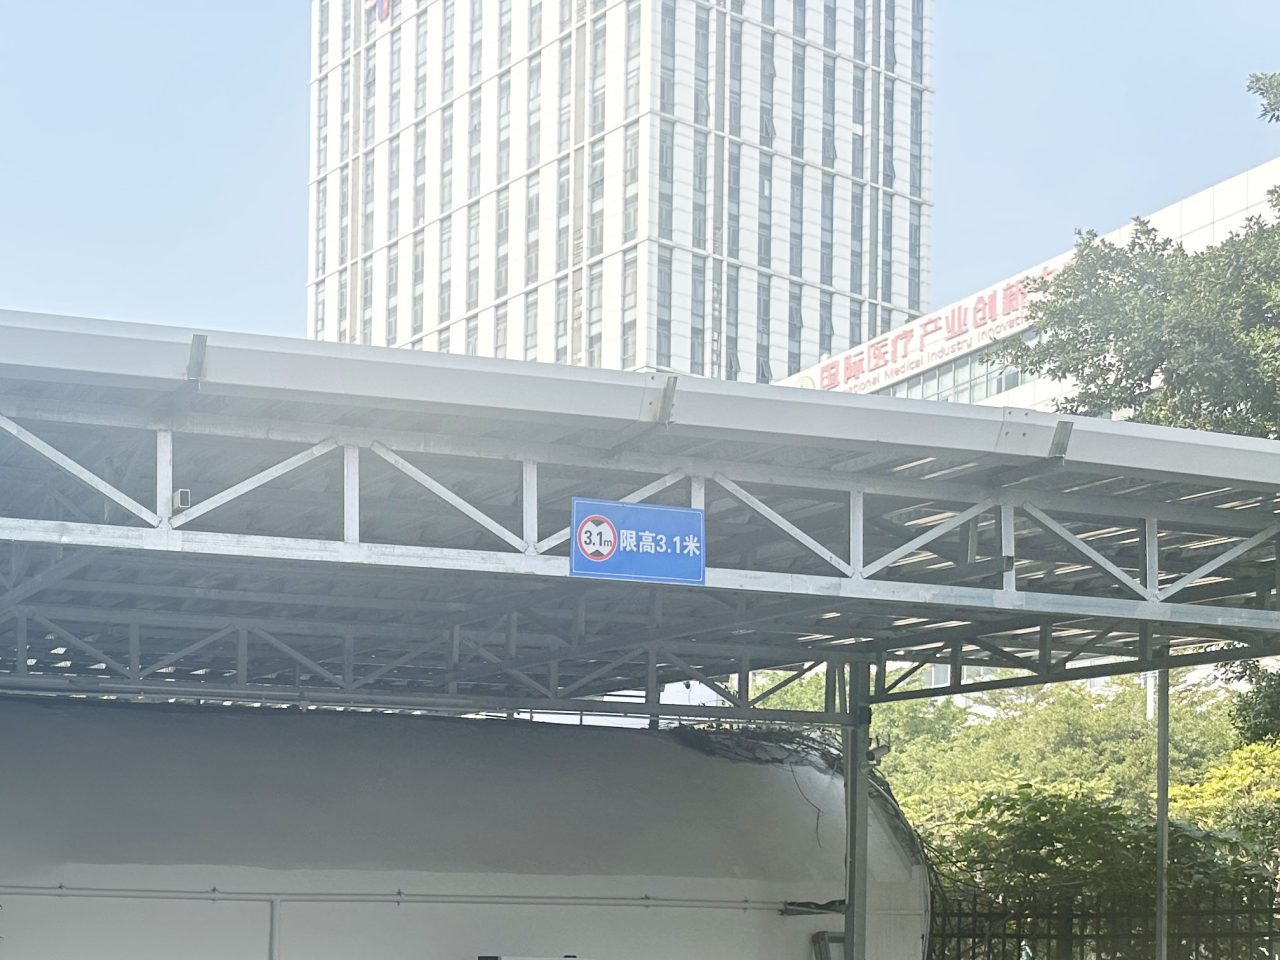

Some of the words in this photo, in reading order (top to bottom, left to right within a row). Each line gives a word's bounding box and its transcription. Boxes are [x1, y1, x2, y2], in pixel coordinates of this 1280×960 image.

[821, 264, 1058, 391] 国际医疗产业创新
[884, 355, 924, 381] Medical
[927, 337, 972, 363] Industry
[583, 529, 613, 548] 3.1m
[619, 528, 701, 557] 限高3.1米
